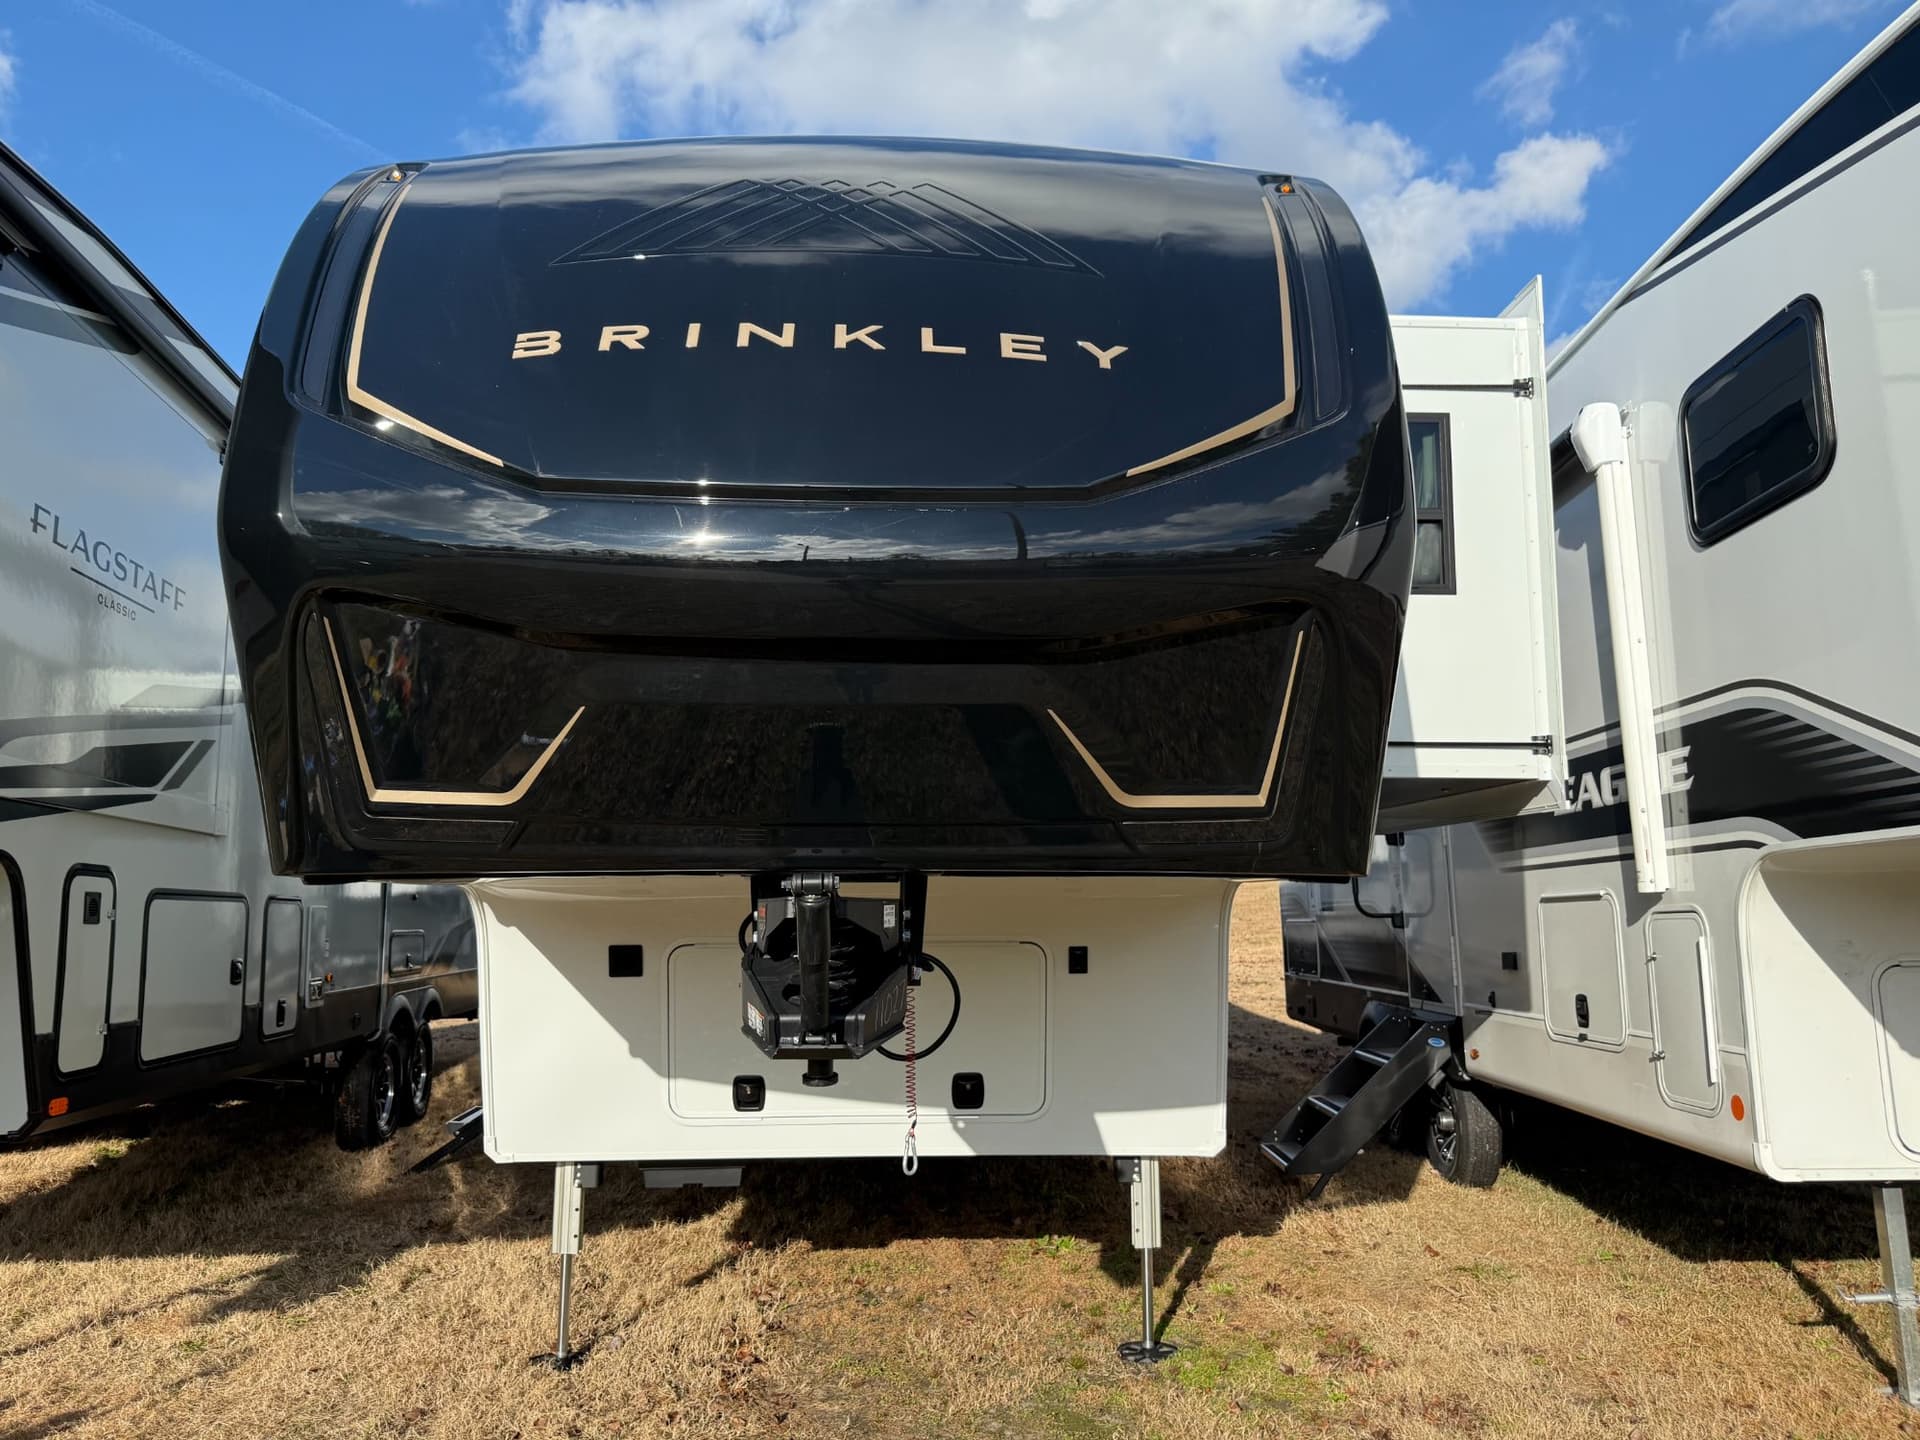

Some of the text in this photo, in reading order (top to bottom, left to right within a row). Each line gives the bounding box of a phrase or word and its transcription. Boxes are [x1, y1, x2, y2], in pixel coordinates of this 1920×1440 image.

[511, 322, 1129, 370] BRINKLEY
[30, 502, 186, 611] FLAGSTAFF
[97, 593, 137, 621] CLASSIC
